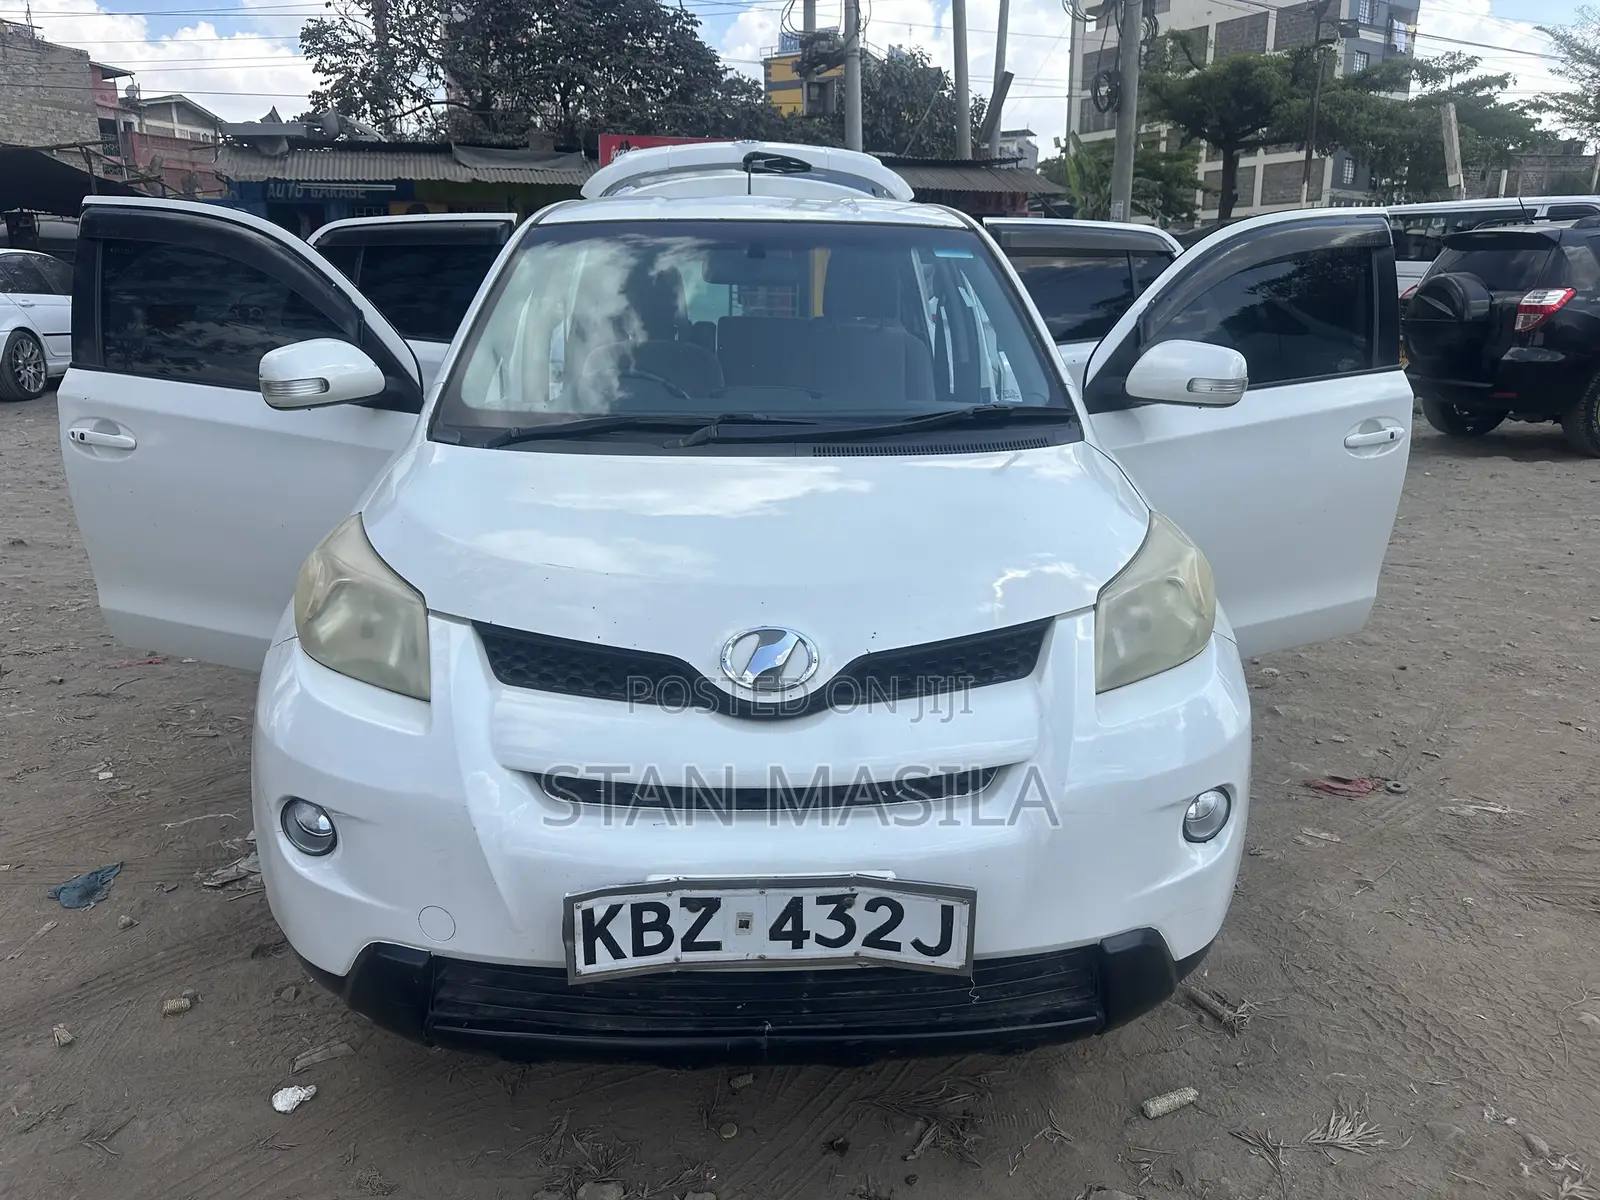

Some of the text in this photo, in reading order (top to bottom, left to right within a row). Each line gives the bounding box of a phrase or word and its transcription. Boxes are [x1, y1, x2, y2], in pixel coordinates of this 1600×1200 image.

[267, 183, 368, 199] AUTO GARAGE
[580, 893, 955, 966] KBZ 432J
